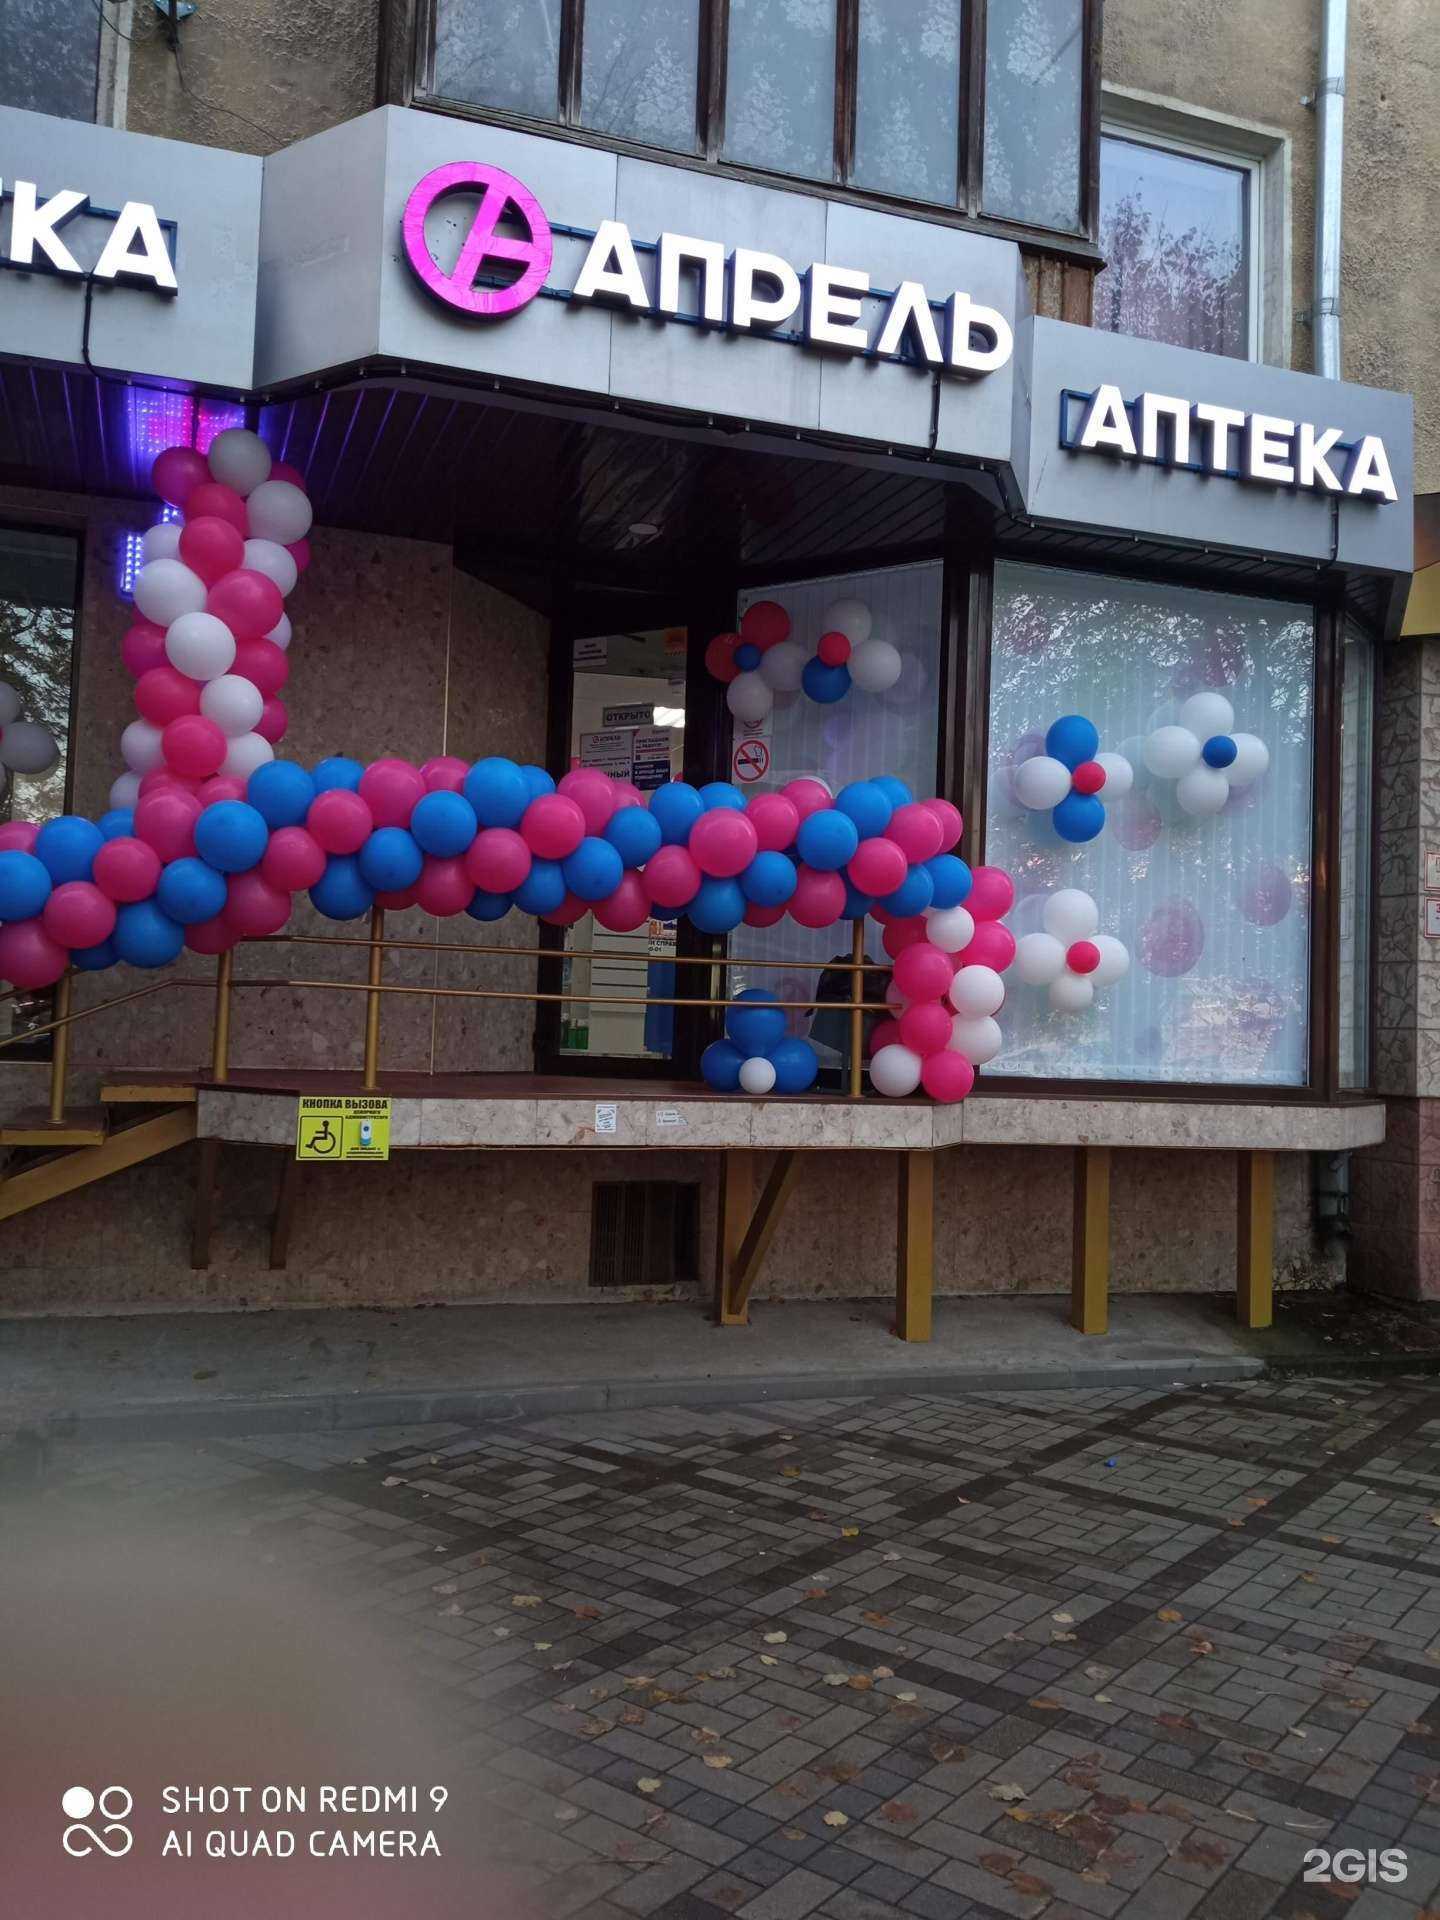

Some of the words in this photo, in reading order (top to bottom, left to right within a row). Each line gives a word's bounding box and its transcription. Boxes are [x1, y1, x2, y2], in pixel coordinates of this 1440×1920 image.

[0, 177, 178, 290] КА
[573, 219, 1015, 373] АПРЕЛЬ
[1081, 384, 1399, 503] АПТЕКА
[606, 711, 651, 722] ОТКРЫТО
[302, 1098, 343, 1109] КНОПКА
[345, 1099, 388, 1109] ВЫЗОВА
